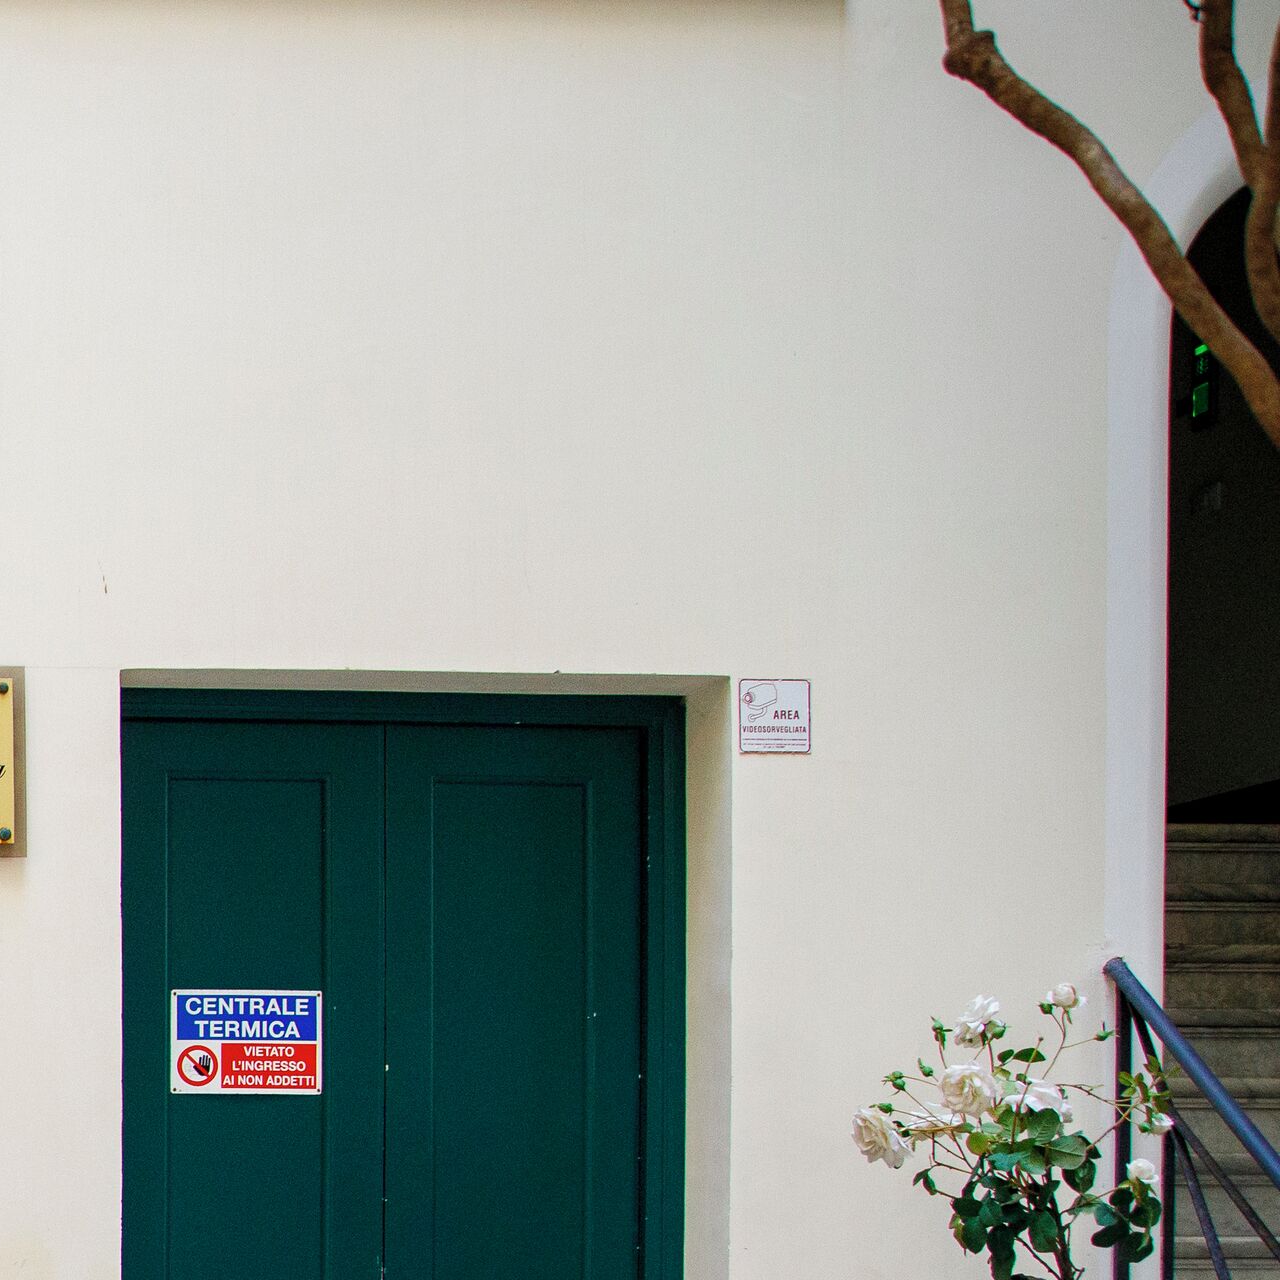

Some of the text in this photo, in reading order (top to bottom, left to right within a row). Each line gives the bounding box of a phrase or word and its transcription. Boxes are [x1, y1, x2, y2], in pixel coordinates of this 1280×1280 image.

[773, 710, 800, 720] AREA
[742, 725, 807, 733] VIDEOSORVEGLIATA
[185, 998, 309, 1016] CENTRALE
[194, 1020, 301, 1038] TERMICA
[243, 1046, 295, 1057] VIETATO
[232, 1061, 306, 1072] L'INGRESSO
[222, 1075, 315, 1087] AI NON ADDETTI
